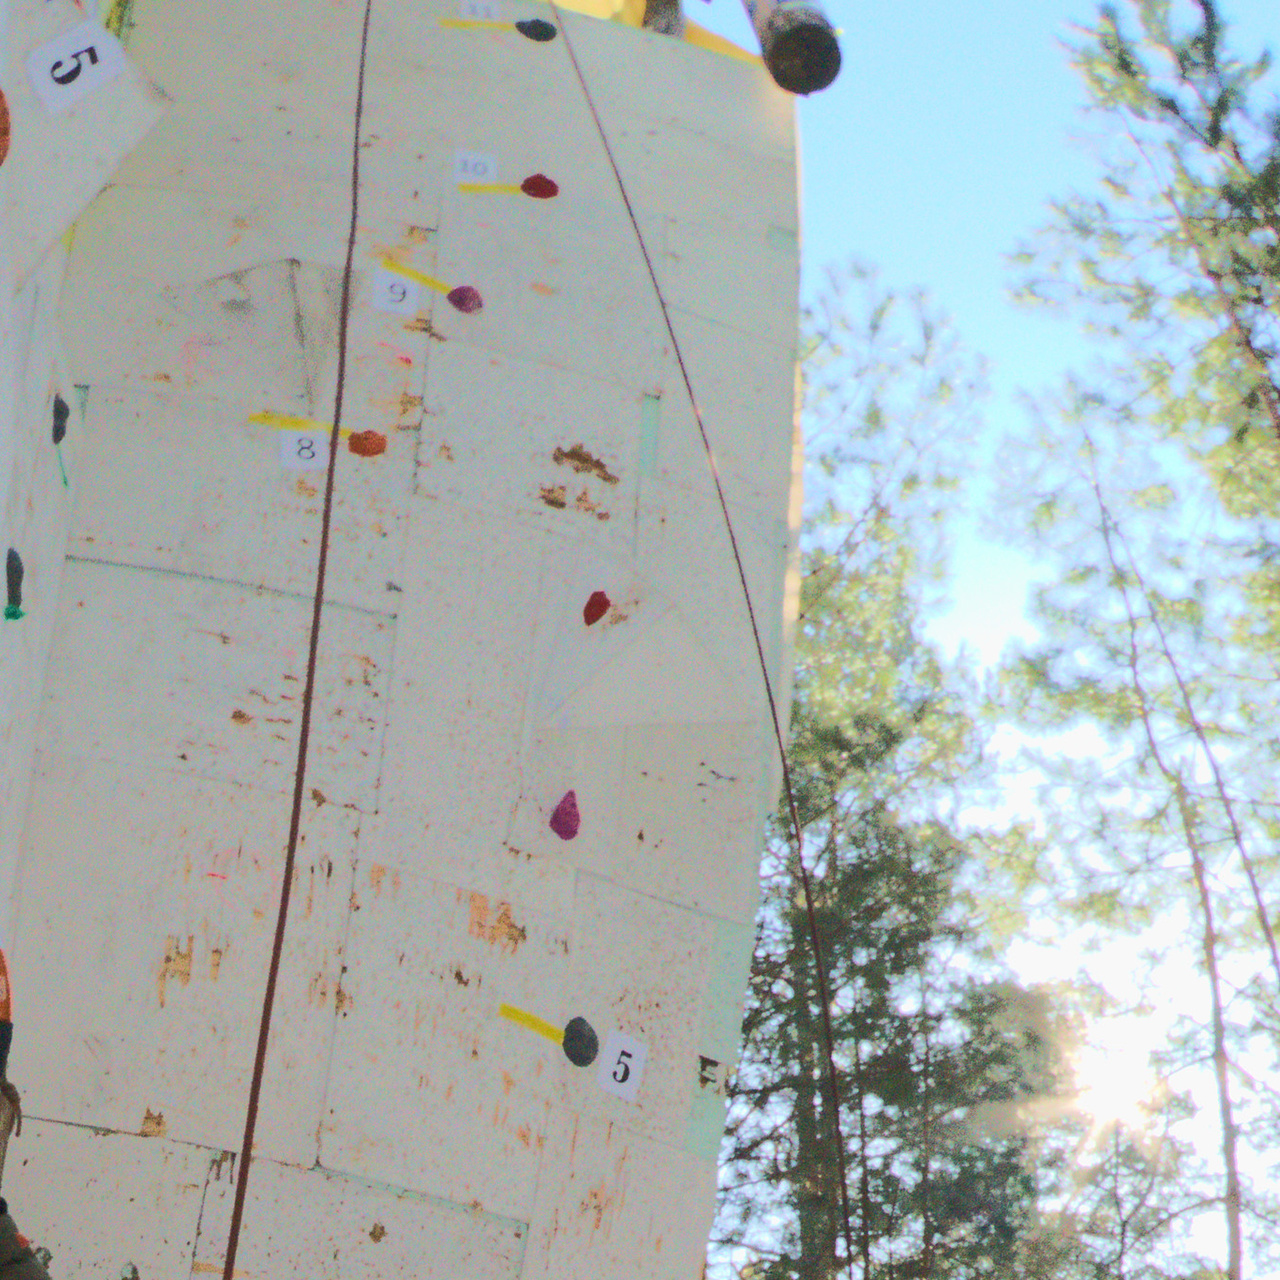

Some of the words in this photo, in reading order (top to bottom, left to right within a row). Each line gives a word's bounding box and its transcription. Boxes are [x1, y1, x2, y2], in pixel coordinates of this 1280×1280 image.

[50, 46, 99, 85] 5
[460, 159, 488, 176] 10
[389, 283, 406, 302] 9
[297, 438, 315, 460] 8
[612, 1050, 632, 1083] 5
